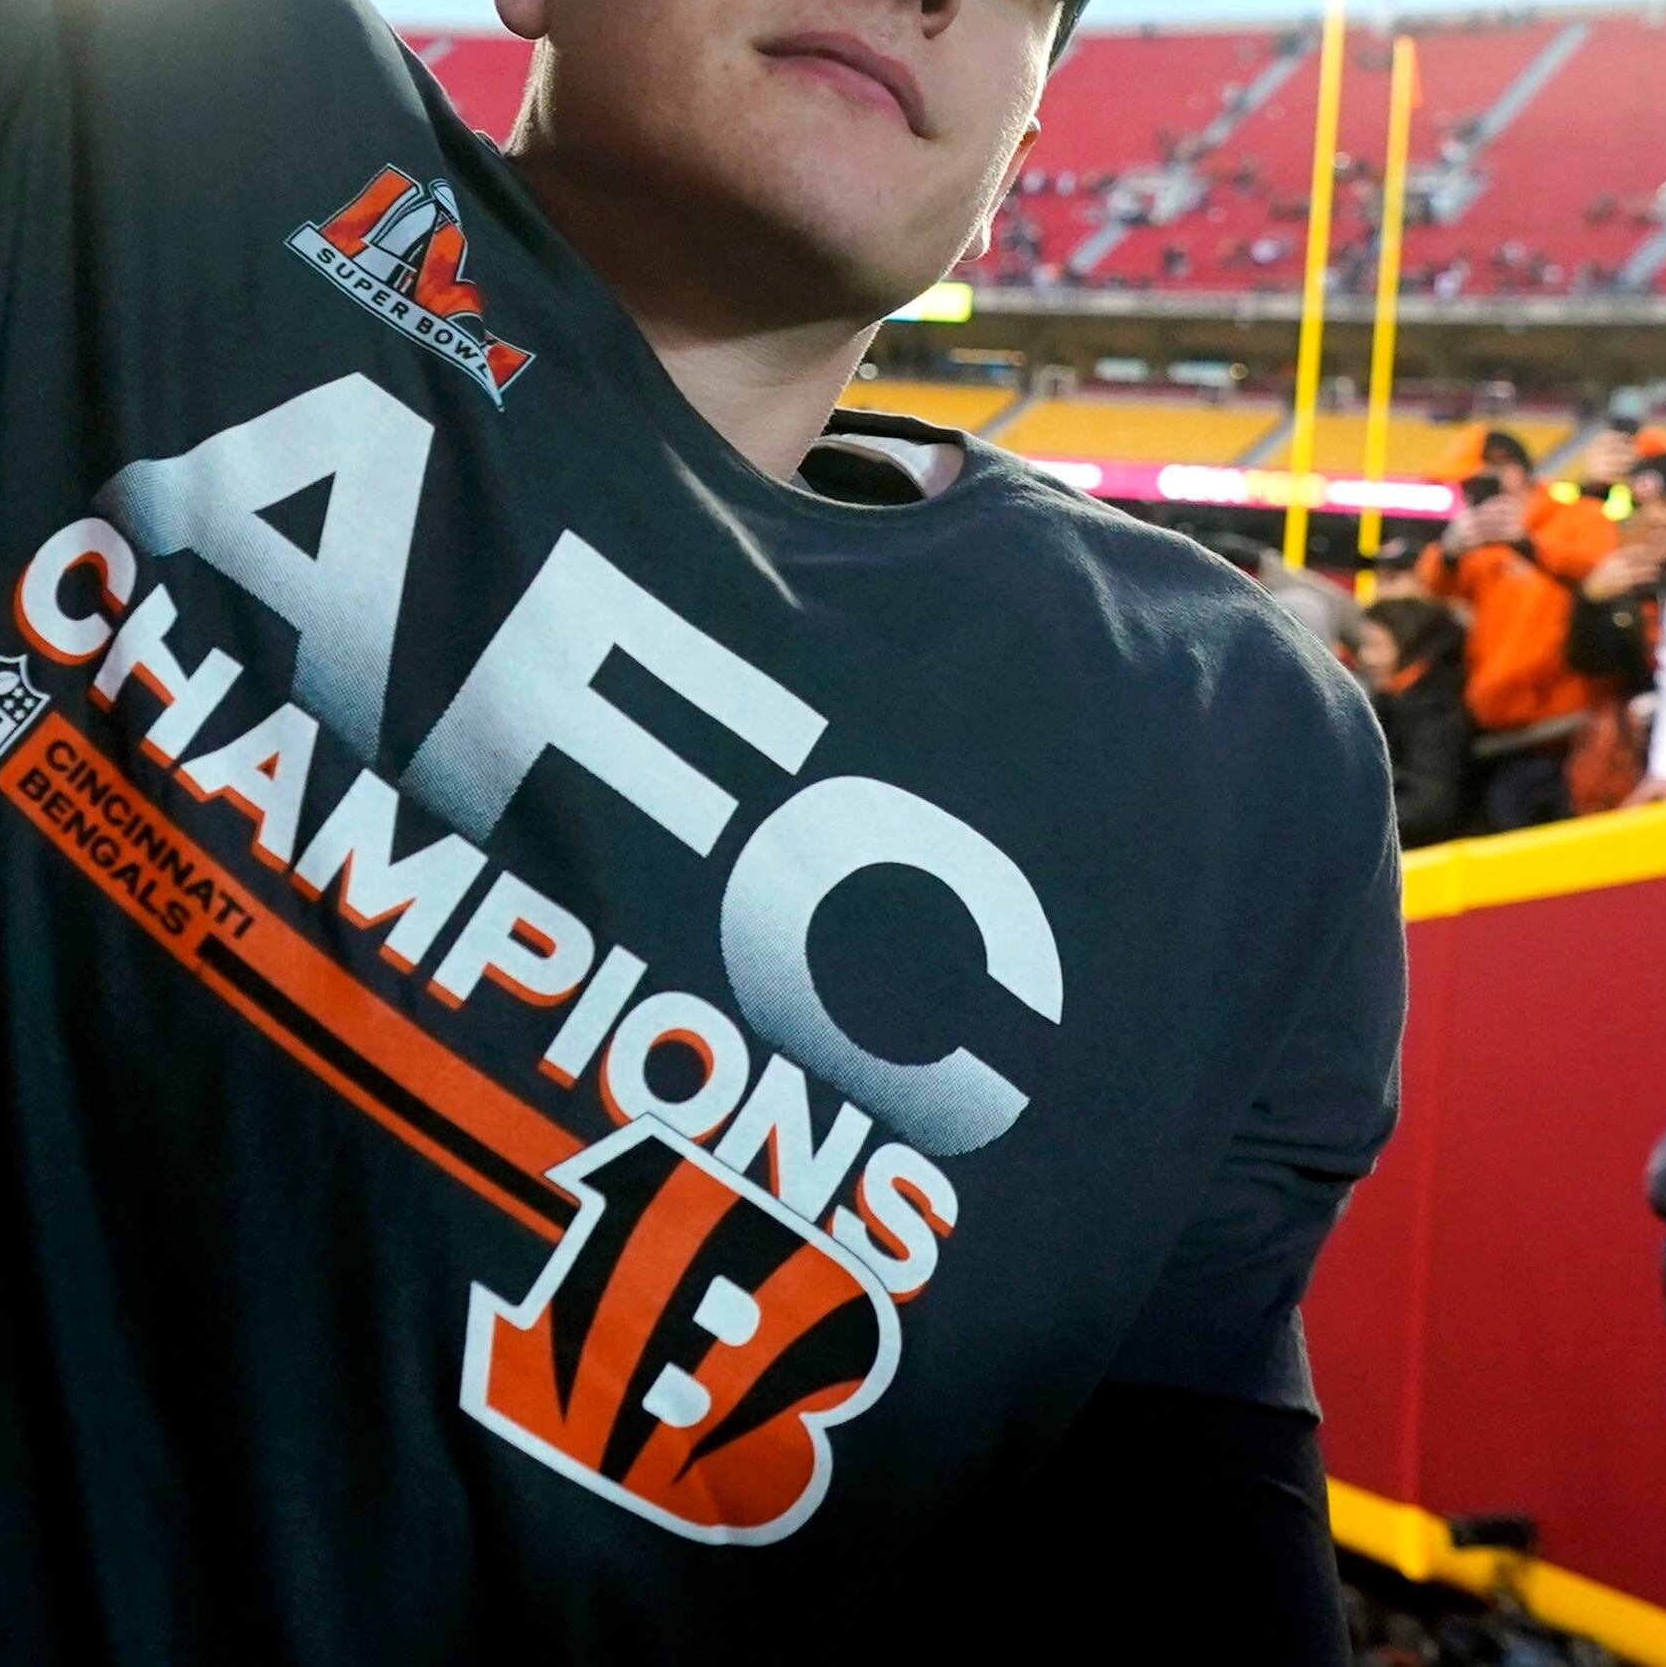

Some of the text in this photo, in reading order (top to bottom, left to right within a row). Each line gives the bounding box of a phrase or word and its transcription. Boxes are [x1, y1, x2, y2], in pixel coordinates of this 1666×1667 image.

[317, 248, 410, 321] SUPER
[17, 766, 192, 936] BENGALS
[44, 739, 255, 940] CINCINNATI
[95, 370, 1063, 1157] AFC
[13, 517, 960, 1305] CHAMPIONS
